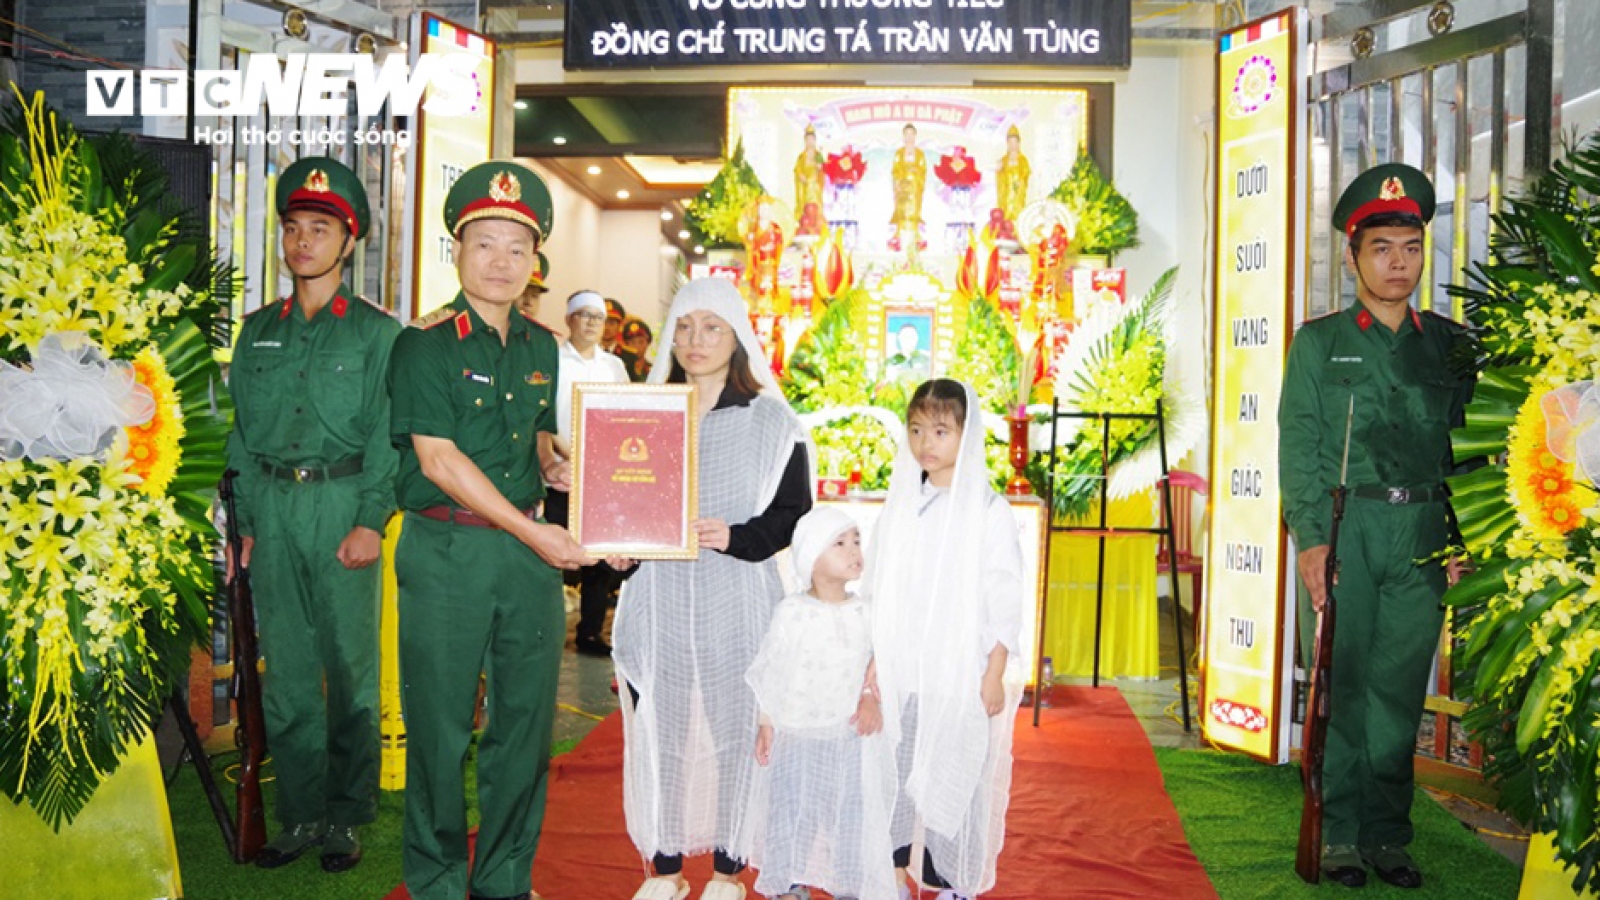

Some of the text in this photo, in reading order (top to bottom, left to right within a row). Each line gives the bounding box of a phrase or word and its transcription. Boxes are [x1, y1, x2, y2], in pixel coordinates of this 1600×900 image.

[591, 19, 1100, 55] ĐỒNG CHÍ TRUNG TÁ TRẦN VĂN TÙNG
[1239, 393, 1259, 422] AN
[1229, 617, 1255, 649] THU
